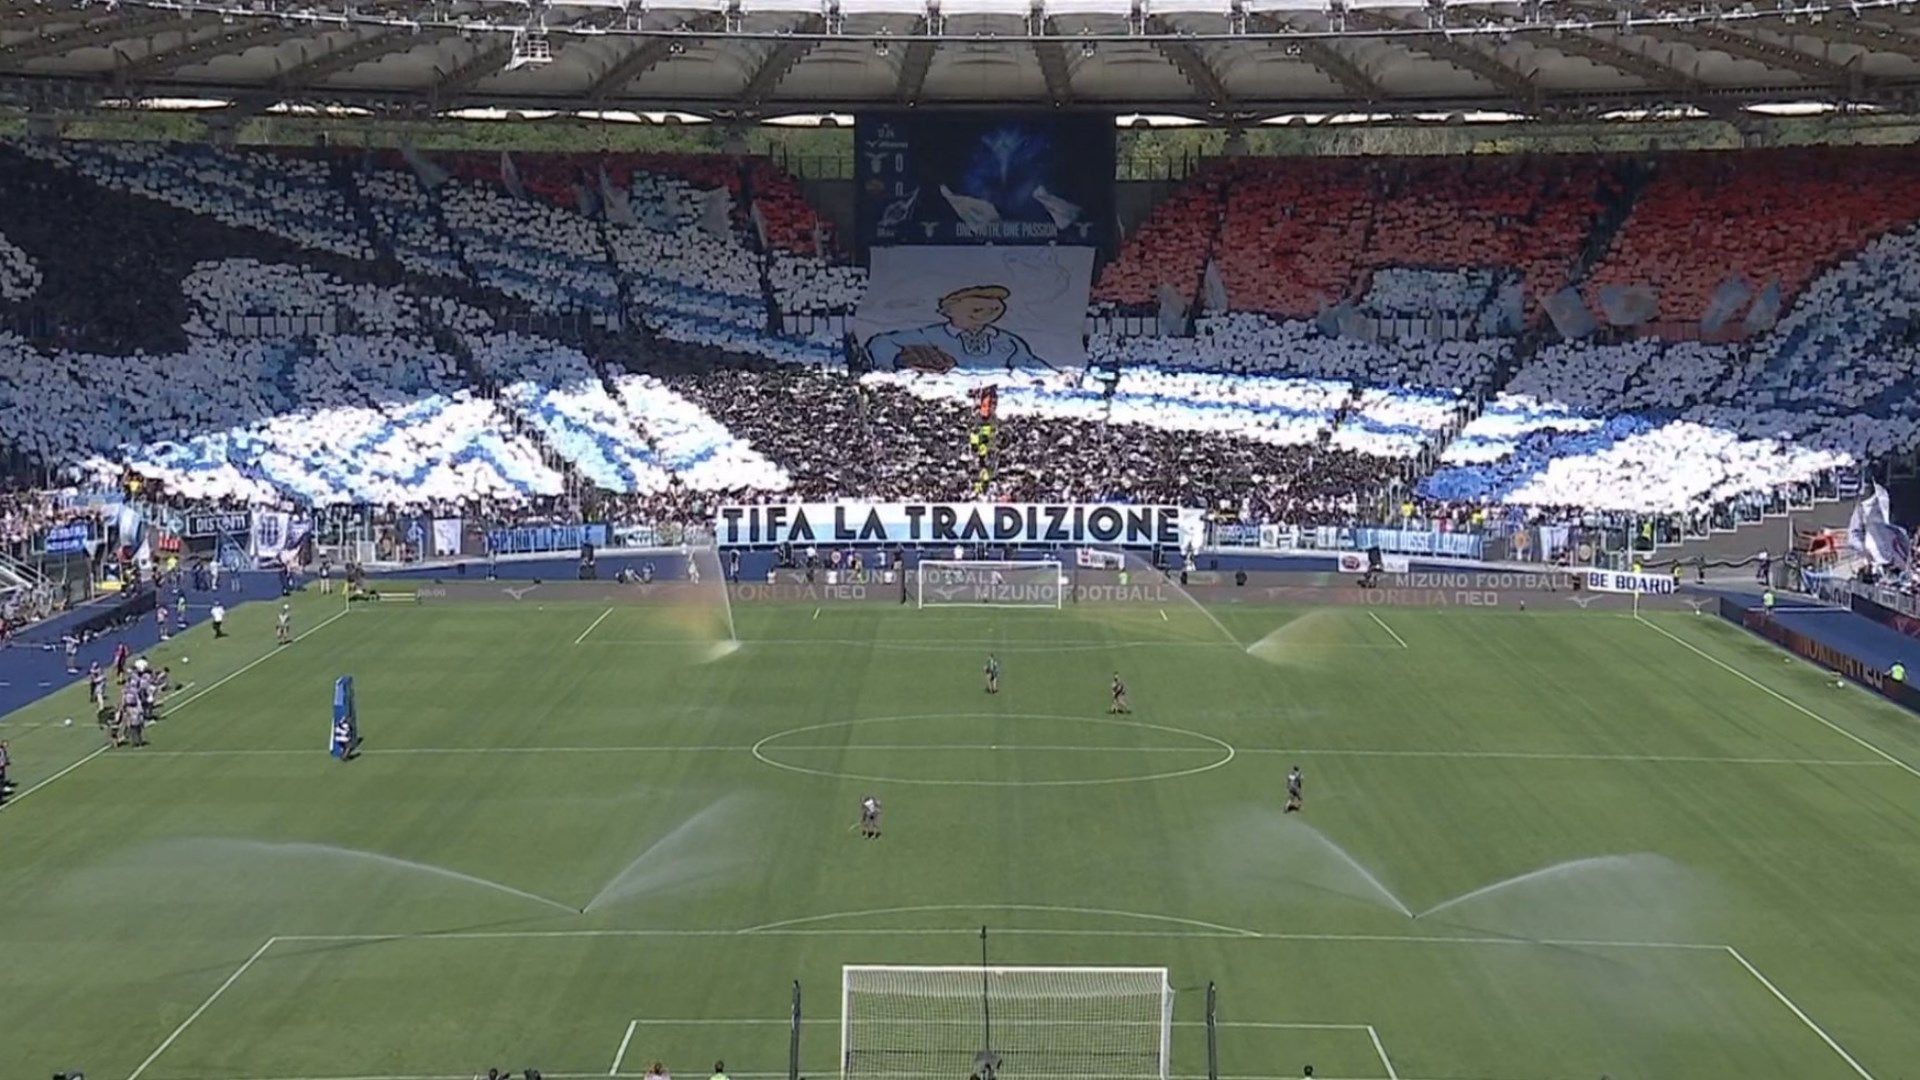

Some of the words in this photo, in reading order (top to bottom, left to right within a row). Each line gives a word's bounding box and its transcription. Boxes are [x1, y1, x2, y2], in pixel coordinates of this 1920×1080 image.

[723, 508, 815, 542] TIFA
[834, 507, 887, 541] LA
[904, 506, 1179, 543] TRADIZIONE
[1396, 573, 1469, 588] MIZUNO
[1476, 573, 1572, 589] FOOTBALL
[1590, 572, 1609, 587] BE
[1615, 574, 1671, 594] BOARD
[975, 585, 1055, 601] MIZUNO
[1061, 585, 1168, 602] FOOTBALL
